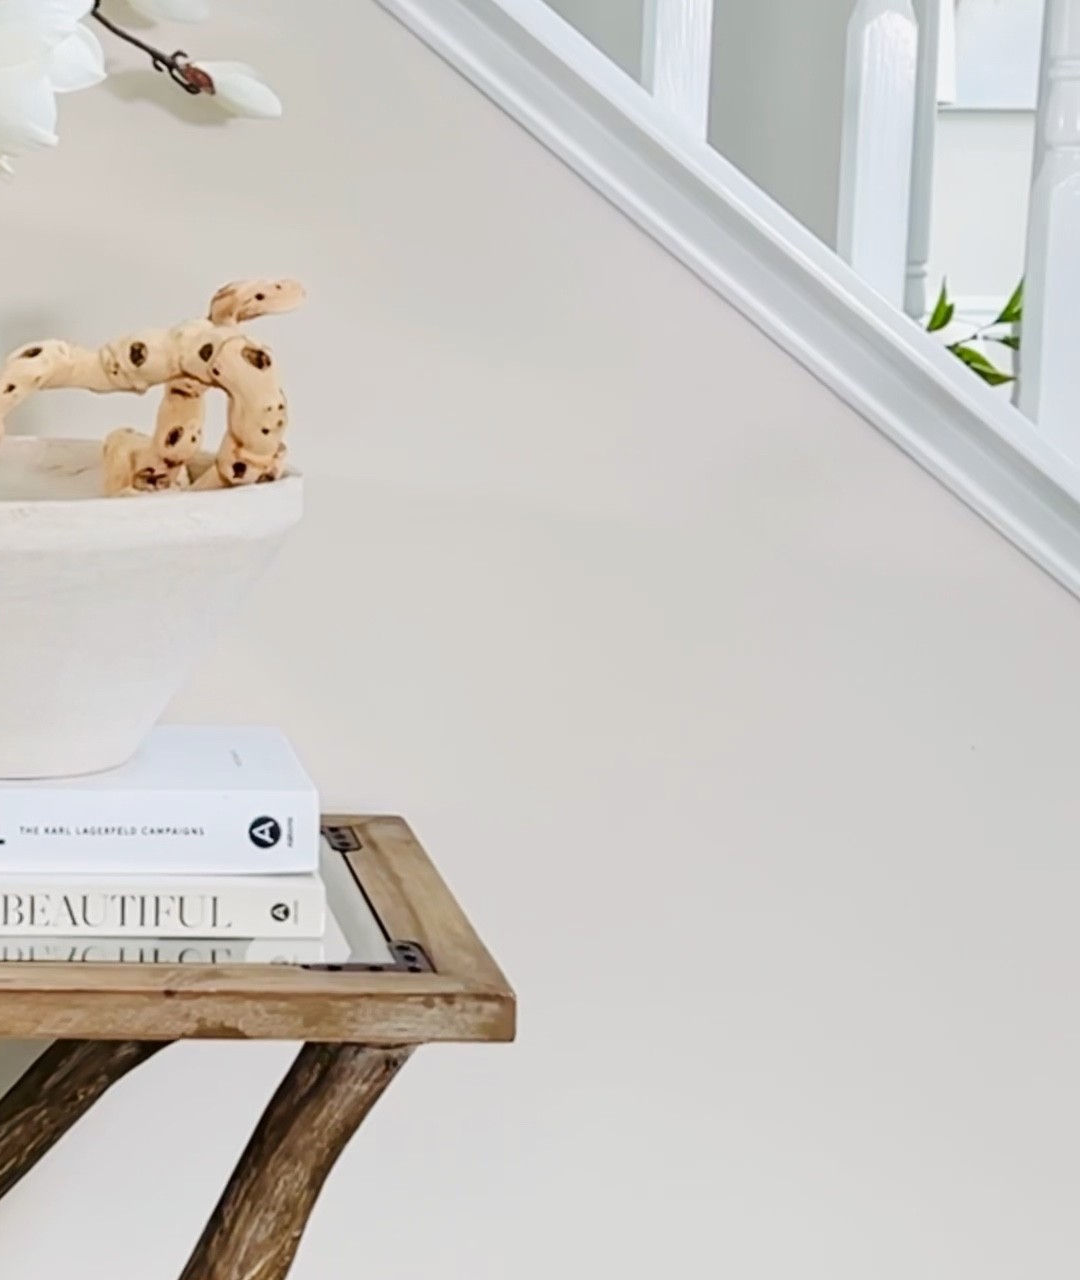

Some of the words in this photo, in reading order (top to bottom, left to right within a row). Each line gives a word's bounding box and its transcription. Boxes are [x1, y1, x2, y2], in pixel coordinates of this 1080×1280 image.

[19, 825, 39, 836] THE
[44, 825, 71, 836] KARL
[75, 825, 137, 836] LAGERFELD
[140, 825, 205, 836] CAMPAIGNS
[1, 893, 232, 928] BEAUTIFUL
